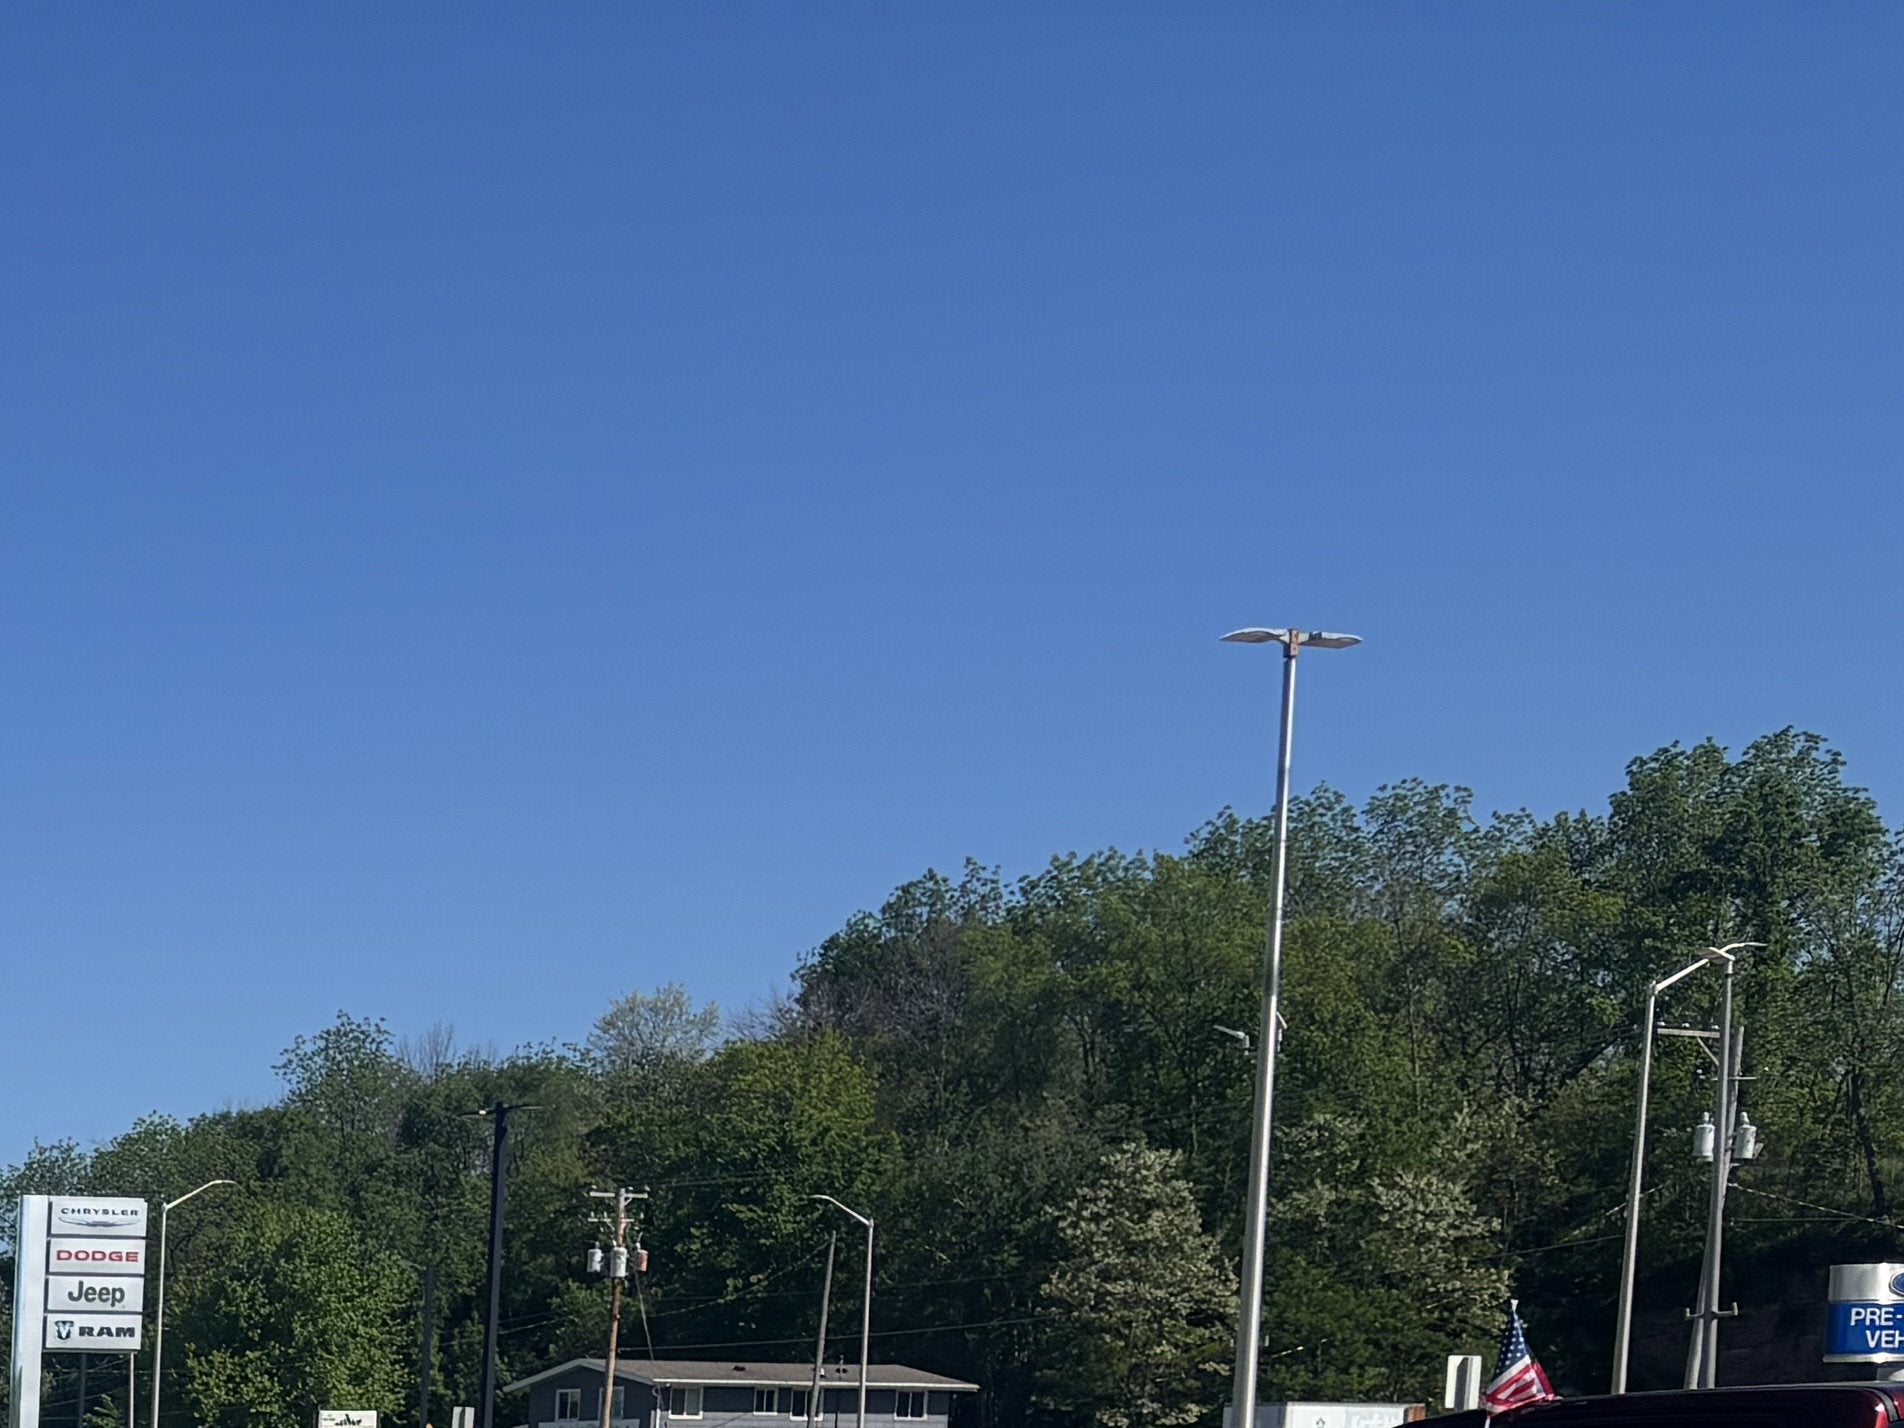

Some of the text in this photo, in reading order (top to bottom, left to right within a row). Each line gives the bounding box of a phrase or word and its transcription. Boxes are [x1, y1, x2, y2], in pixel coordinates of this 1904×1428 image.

[60, 1207, 138, 1216] CHRYSLER
[56, 1249, 140, 1263] DODGE
[67, 1280, 126, 1308] Jeep
[1850, 1307, 1903, 1326] PRE-
[78, 1326, 135, 1338] RAM
